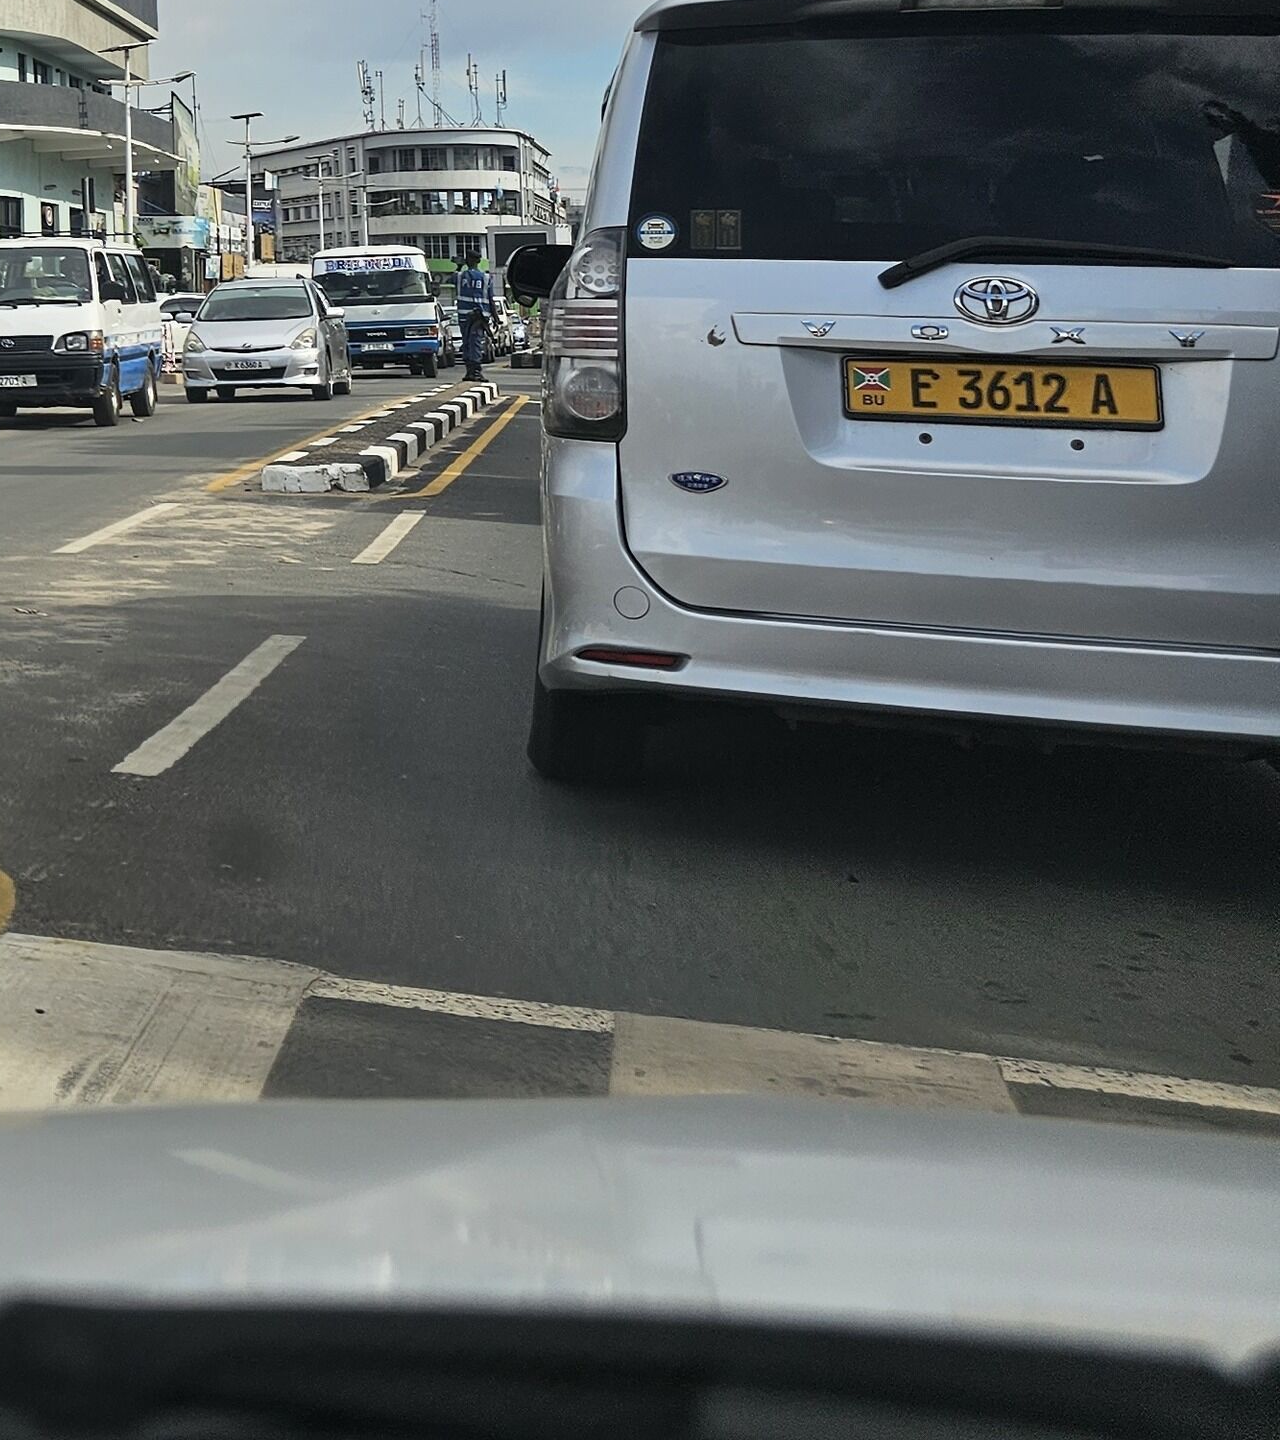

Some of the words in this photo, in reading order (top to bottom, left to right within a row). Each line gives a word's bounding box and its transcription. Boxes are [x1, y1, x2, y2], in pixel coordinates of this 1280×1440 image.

[862, 394, 885, 406] BU
[910, 368, 940, 408] E
[957, 370, 1070, 413] 3612
[1091, 373, 1119, 415] A
